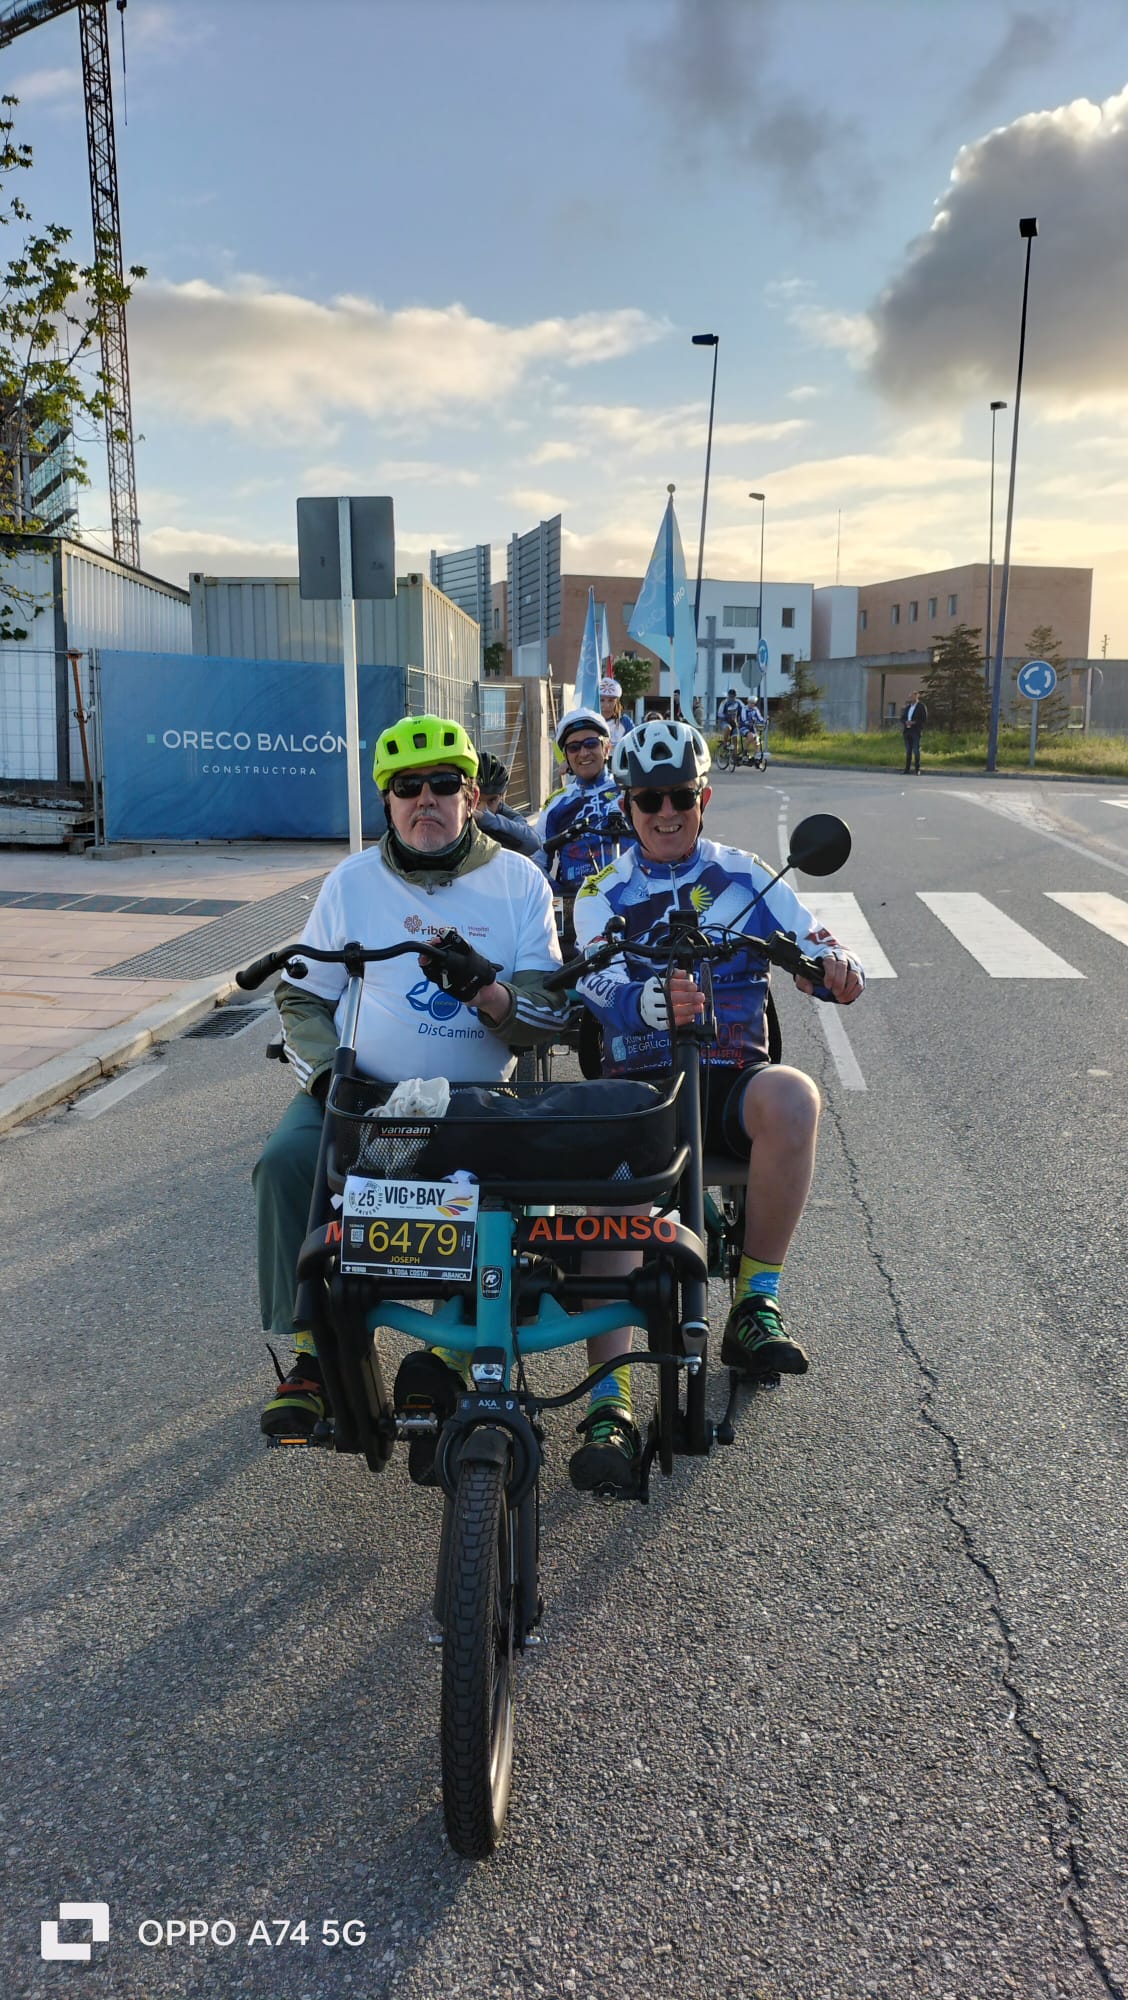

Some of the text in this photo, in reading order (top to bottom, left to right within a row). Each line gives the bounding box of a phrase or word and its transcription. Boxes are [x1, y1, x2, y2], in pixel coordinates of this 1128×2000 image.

[162, 729, 251, 750] ORECO
[202, 765, 317, 776] CONSTRUCTORA
[418, 1023, 485, 1039] DisCamino
[638, 1038, 671, 1052] GALICI
[381, 1126, 431, 1134] vanraam
[358, 1190, 375, 1207] 25
[384, 1186, 408, 1205] VIG
[416, 1187, 446, 1206] BAY
[528, 1215, 678, 1243] ALONSO
[368, 1220, 458, 1256] 6479
[389, 1255, 421, 1264] JOSEPH
[442, 1271, 467, 1279] ABANCA
[478, 1399, 497, 1407] AXA
